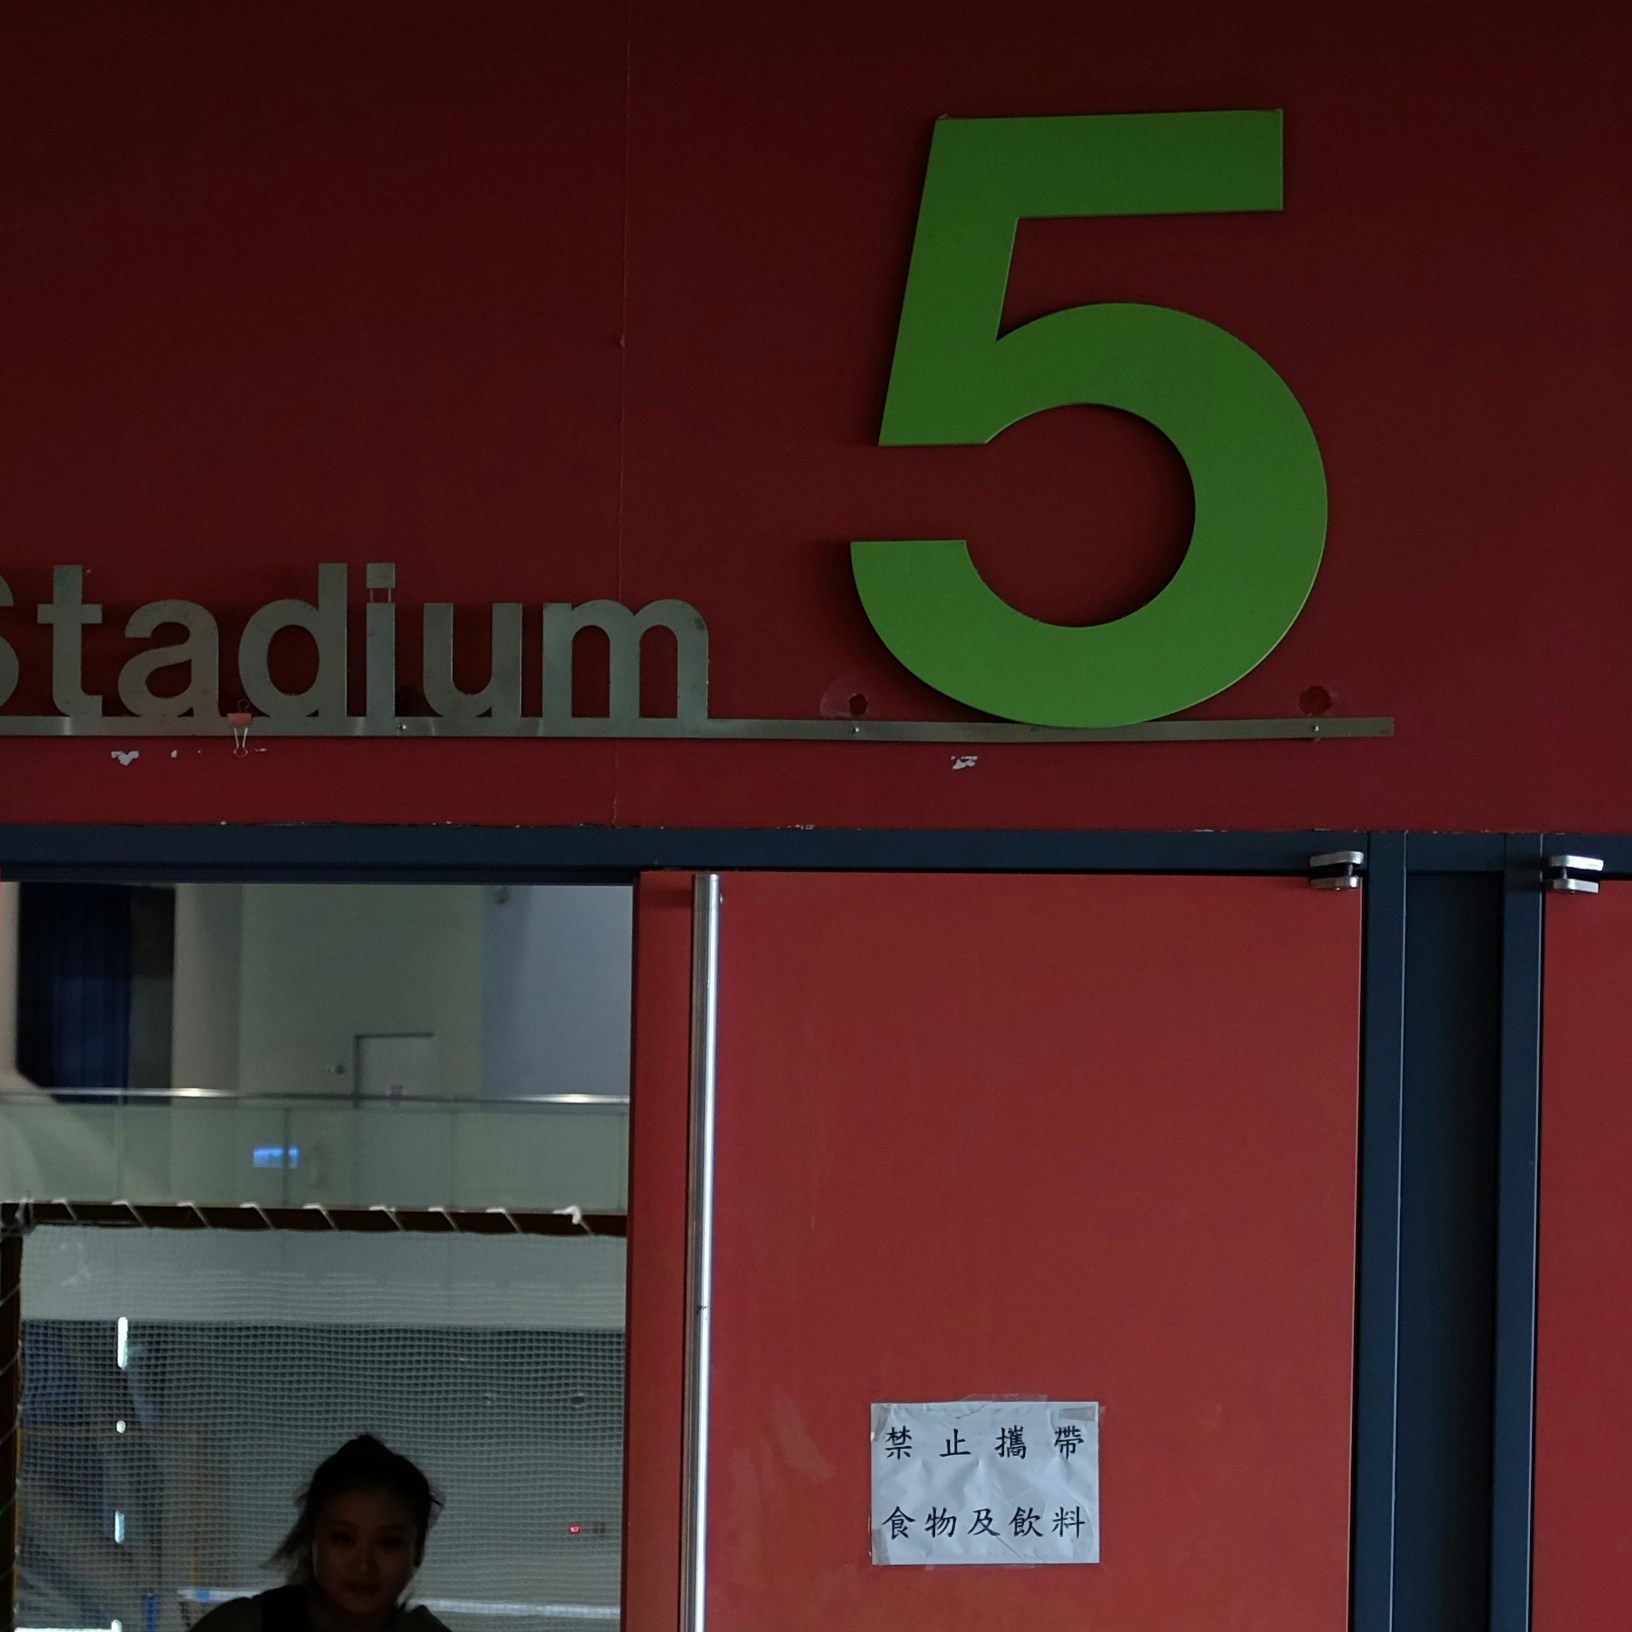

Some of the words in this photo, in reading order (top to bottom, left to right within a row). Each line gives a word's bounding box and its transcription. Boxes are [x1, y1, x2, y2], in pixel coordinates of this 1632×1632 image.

[850, 108, 1329, 729] 5
[885, 1425, 1084, 1460] 禁止攜帶
[881, 1505, 1086, 1540] 食物及飲料
